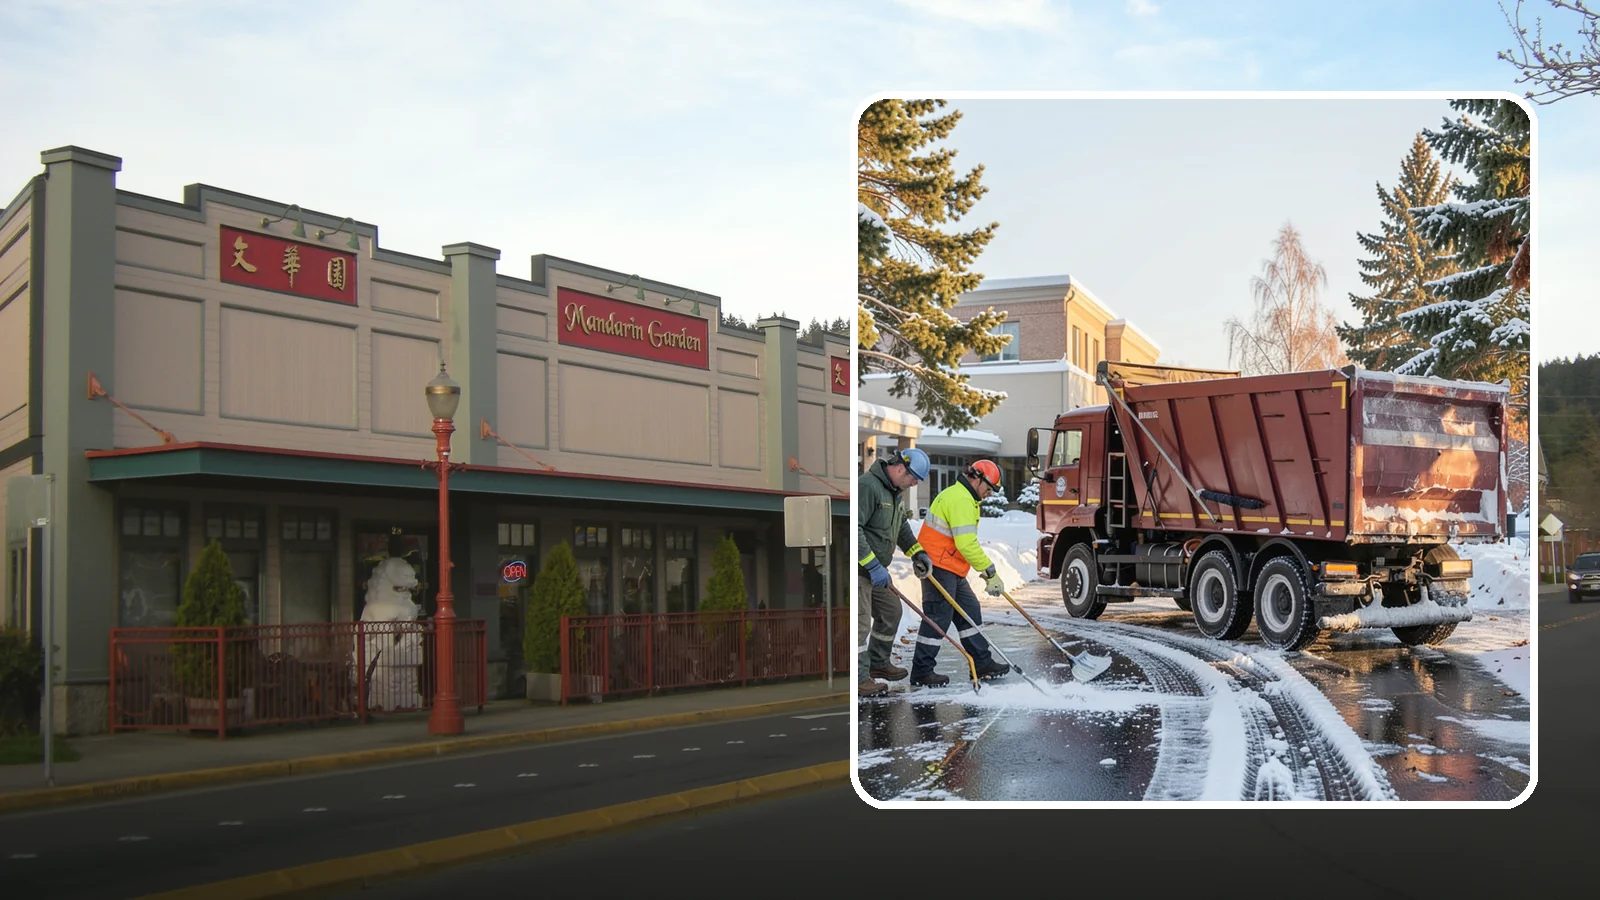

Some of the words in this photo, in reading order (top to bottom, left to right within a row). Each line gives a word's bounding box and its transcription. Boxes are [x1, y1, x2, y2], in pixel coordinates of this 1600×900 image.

[231, 236, 346, 291] 文華園
[564, 302, 644, 341] Mandarin
[647, 320, 701, 352] Garden
[503, 565, 527, 578] OPEN
